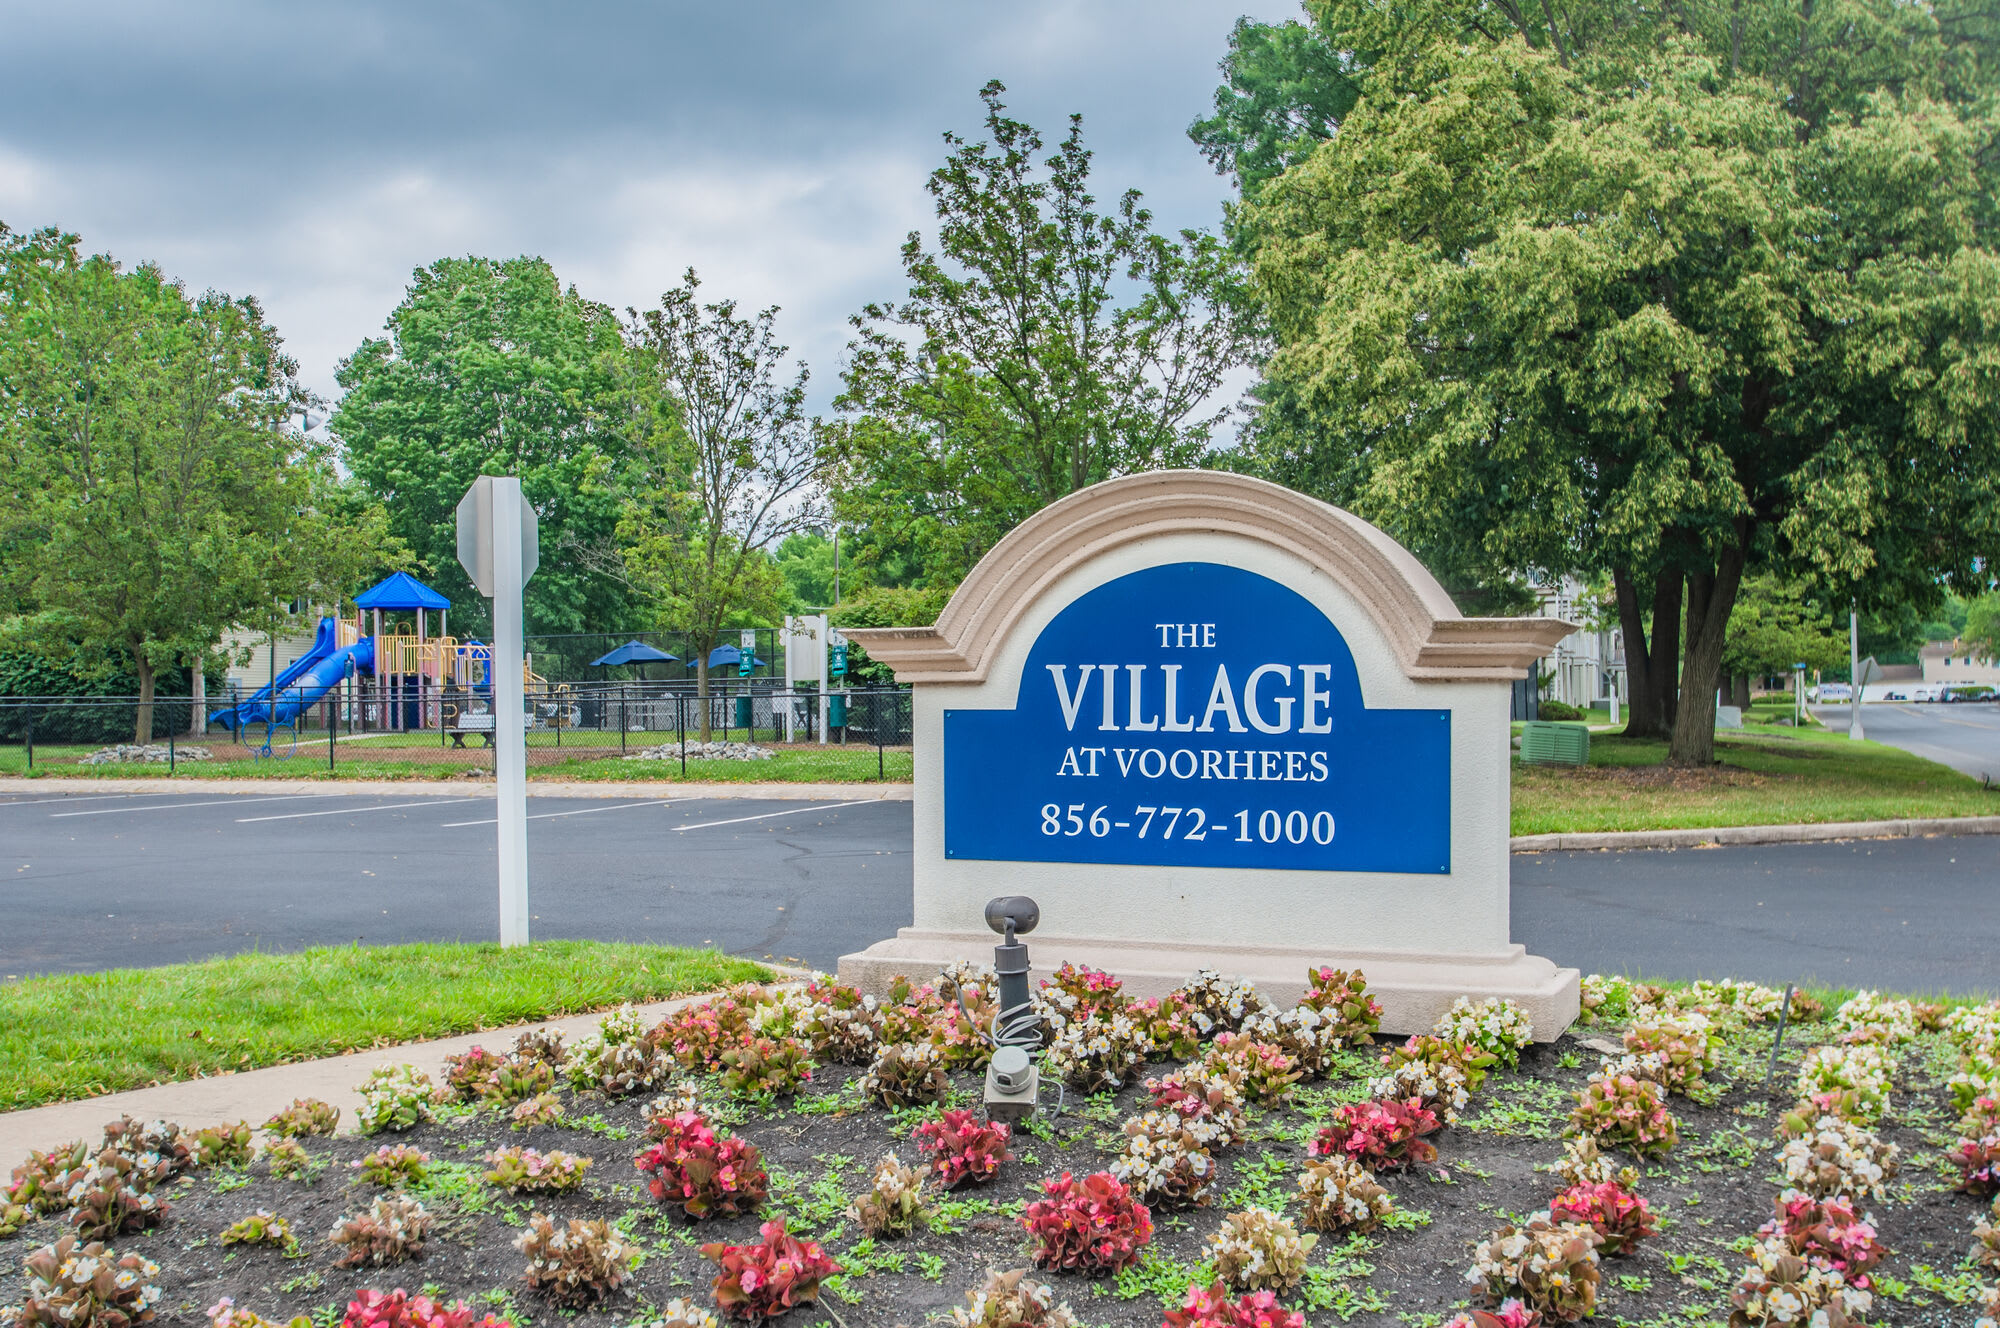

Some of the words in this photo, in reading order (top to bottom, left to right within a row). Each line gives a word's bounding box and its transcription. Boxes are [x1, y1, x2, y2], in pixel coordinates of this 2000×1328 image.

[1155, 622, 1217, 649] THE
[1044, 663, 1334, 735] VILLAGE
[1056, 745, 1106, 778] AT
[1112, 748, 1330, 782] VOORHEES
[1041, 802, 1336, 845] 856-772-1000
